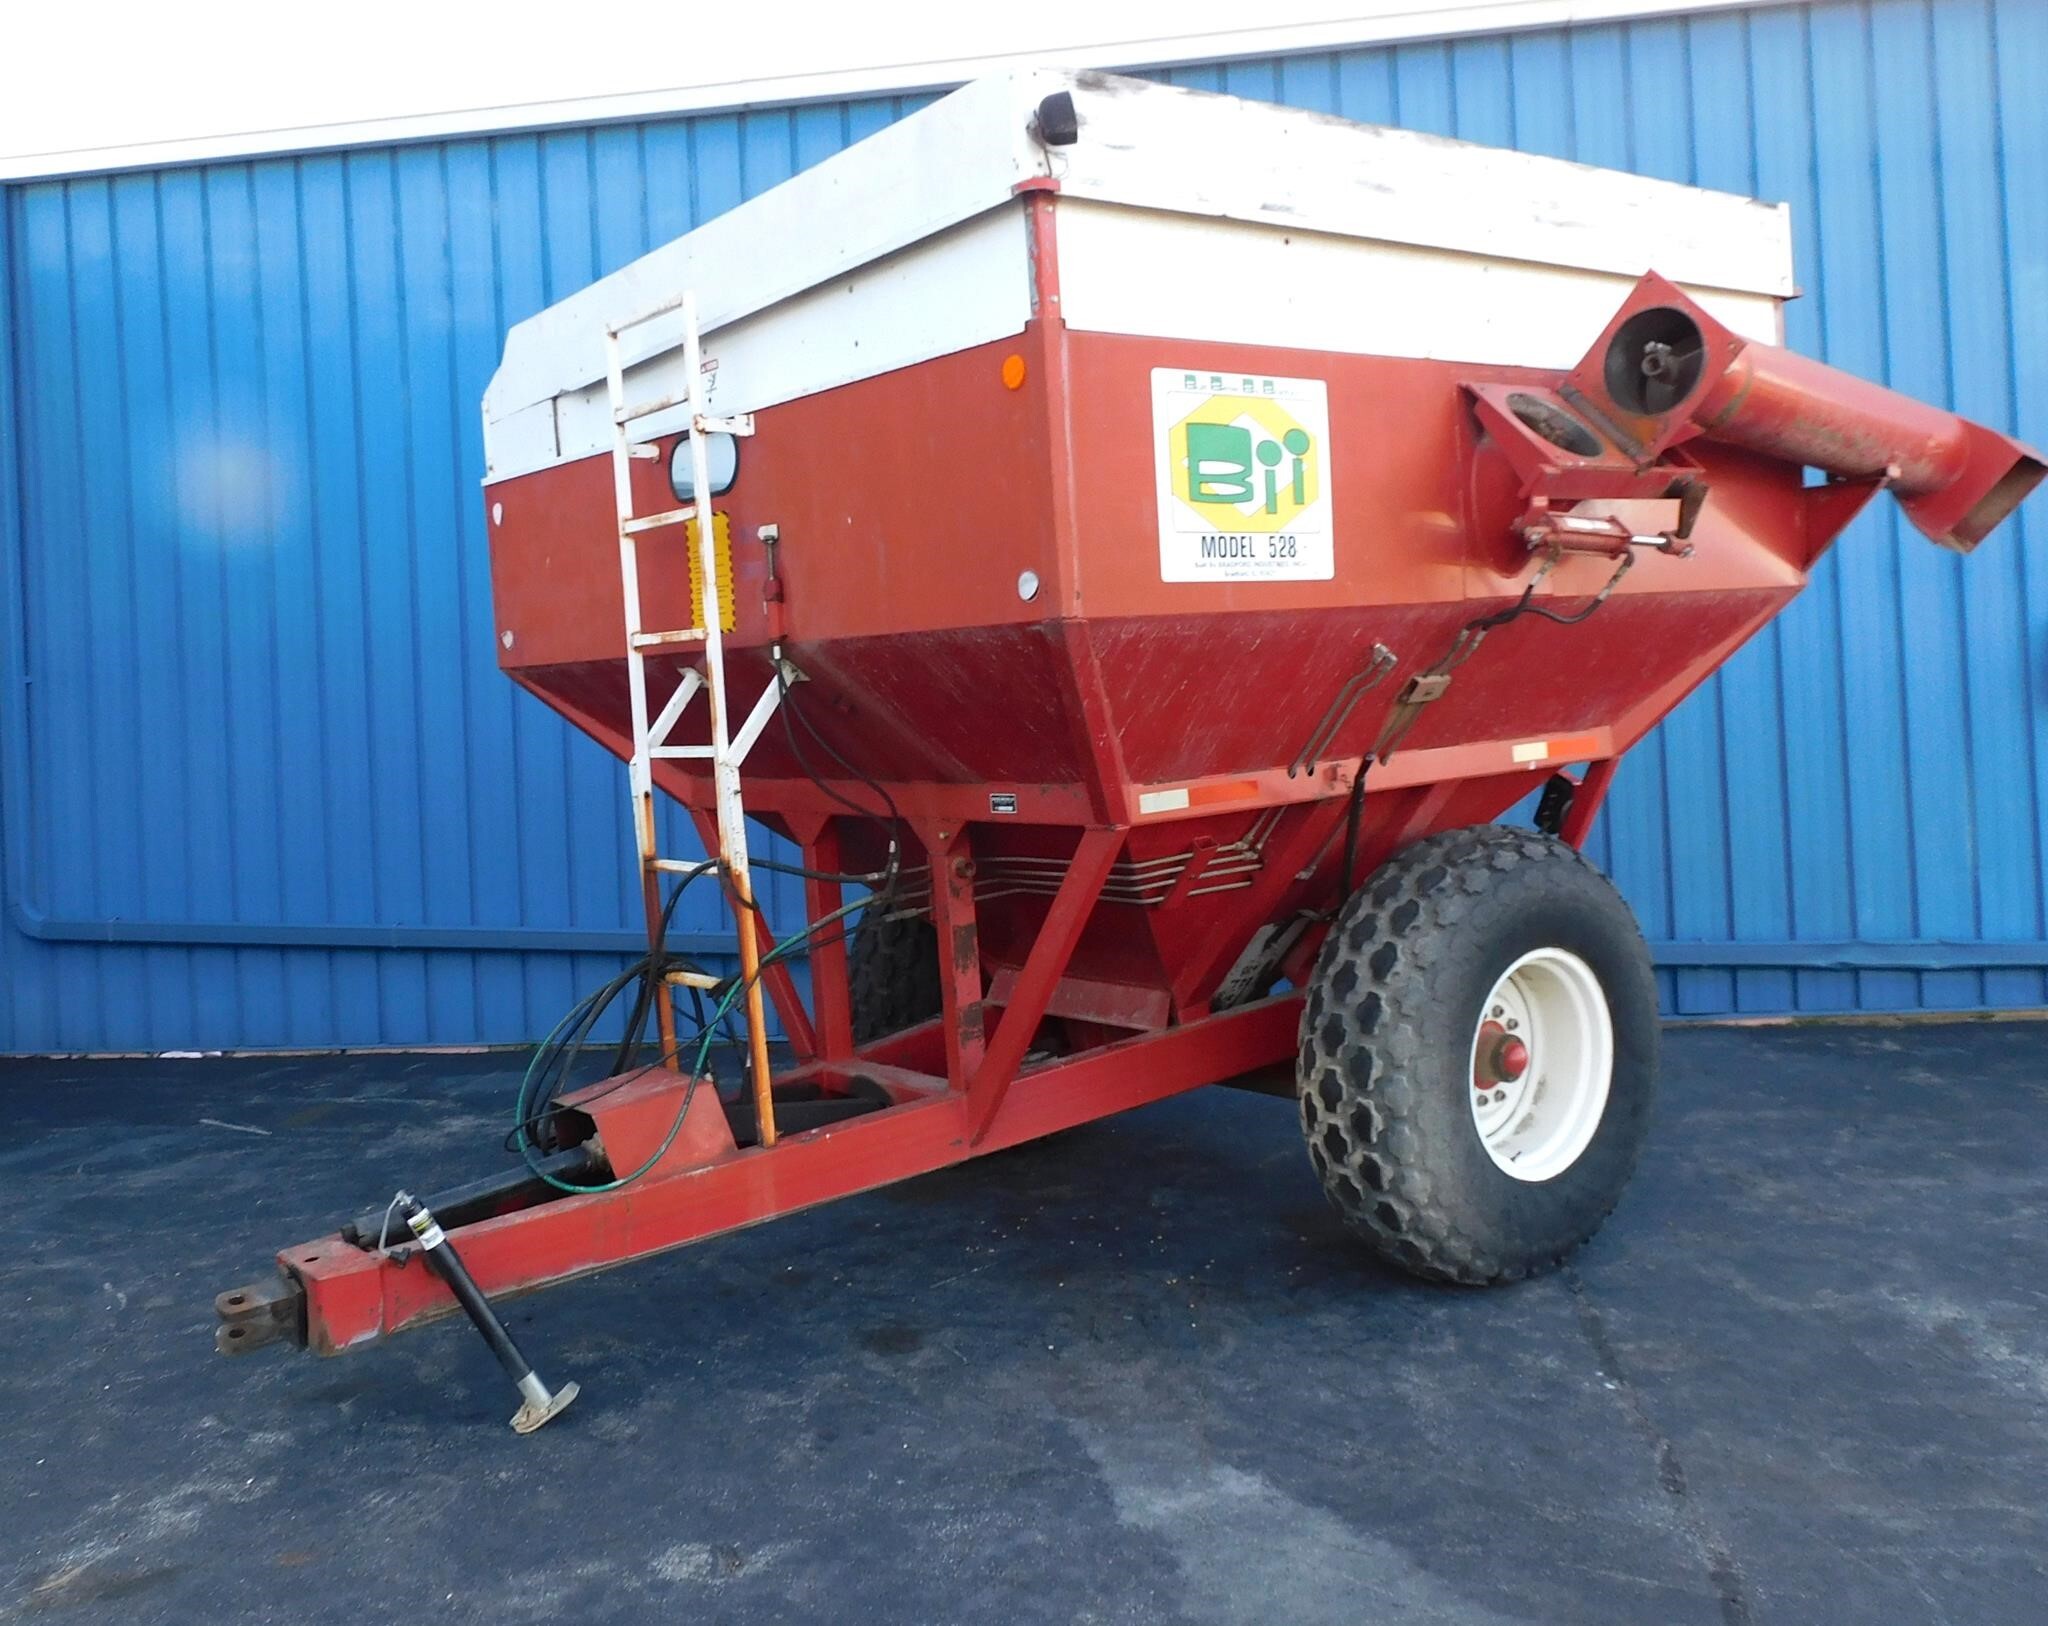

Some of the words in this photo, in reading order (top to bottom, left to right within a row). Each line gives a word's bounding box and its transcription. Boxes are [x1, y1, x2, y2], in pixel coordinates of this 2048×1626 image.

[1186, 422, 1310, 515] Bii
[1201, 535, 1256, 558] MODEL
[1269, 535, 1297, 559] 528
